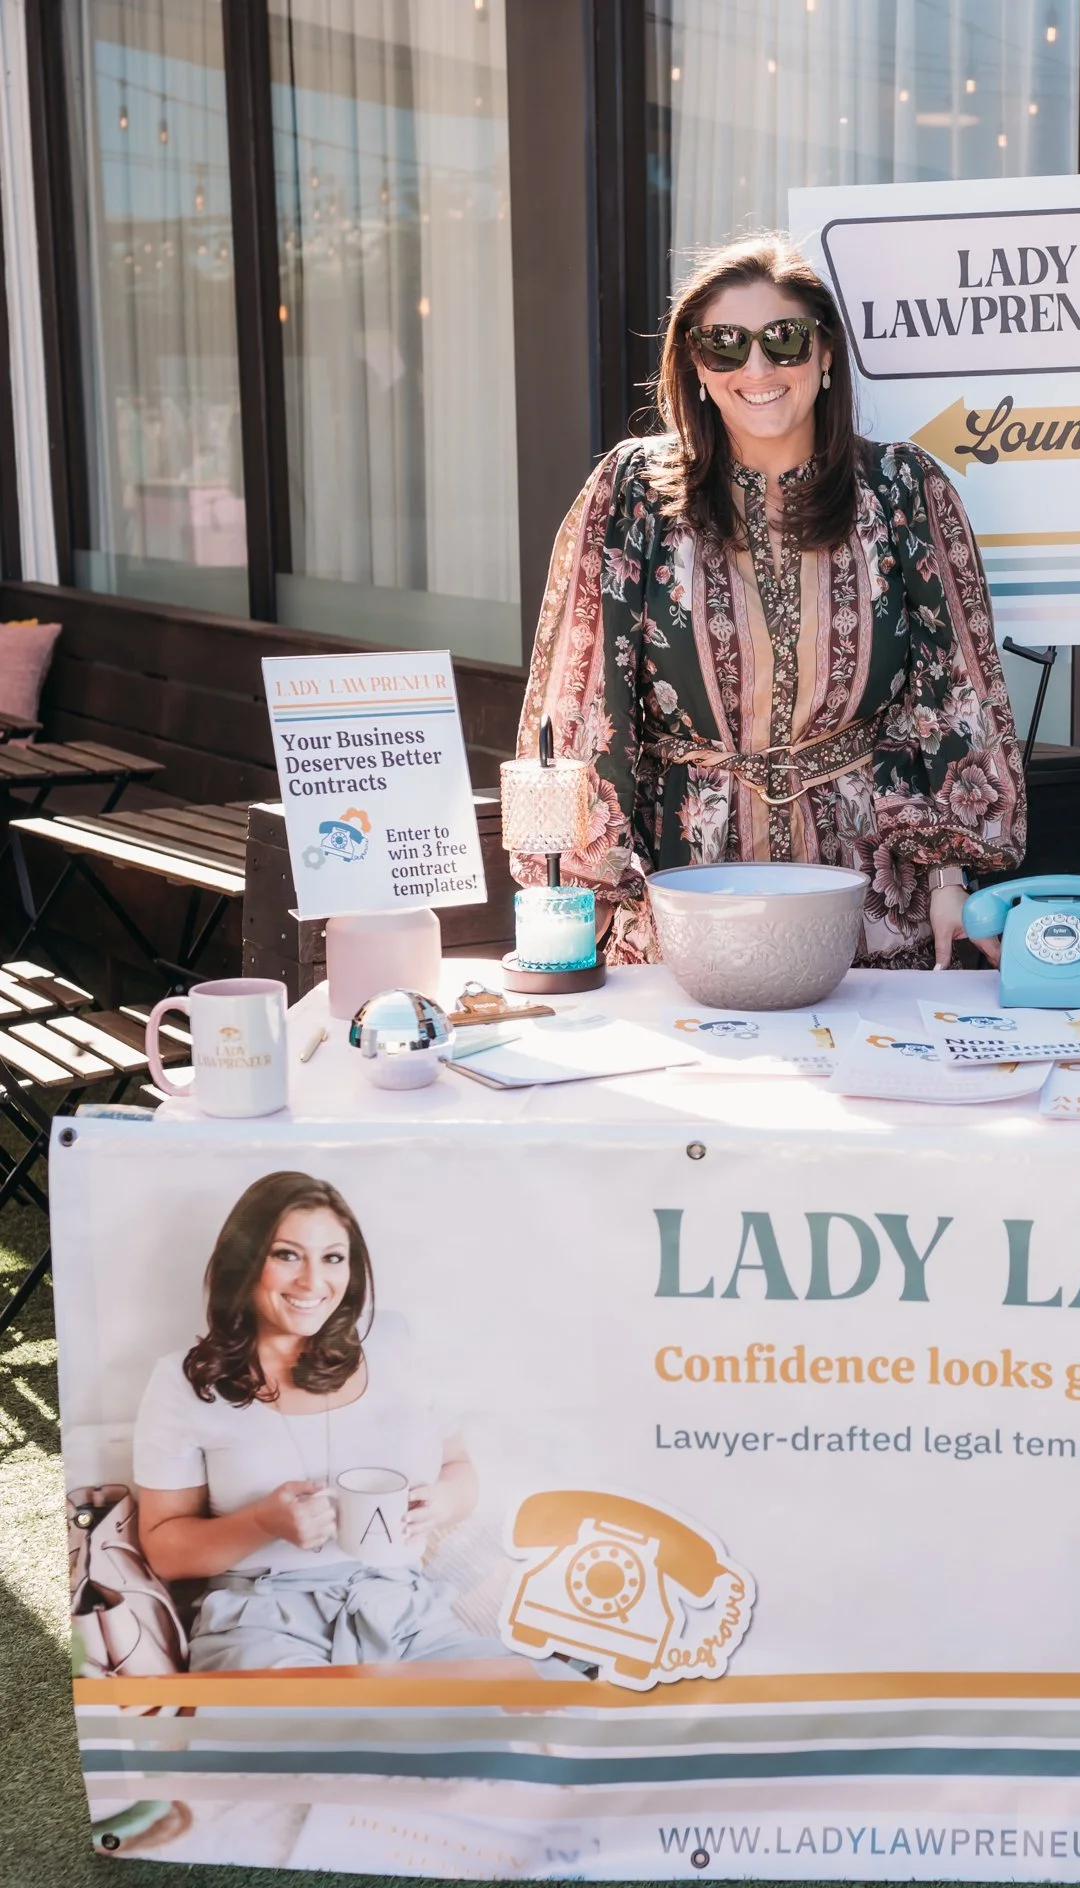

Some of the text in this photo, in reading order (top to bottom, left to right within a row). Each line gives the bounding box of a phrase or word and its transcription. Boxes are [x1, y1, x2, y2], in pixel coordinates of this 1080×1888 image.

[956, 244, 1077, 289] LADY
[275, 673, 447, 697] LADY LAWPRENEUR
[281, 727, 425, 751] Your Business
[284, 750, 442, 774] Deserves Better
[288, 774, 387, 796] Contracts
[386, 825, 450, 843] Enter to
[388, 844, 419, 861] win
[422, 843, 432, 858] 3
[436, 841, 467, 857] free
[391, 860, 458, 879] contract
[393, 874, 478, 897] templates!
[653, 1208, 954, 1302] LADY
[654, 1343, 915, 1384] Confidence
[927, 1347, 1053, 1389] looks
[655, 1424, 911, 1457] Lawyer-drafted
[924, 1427, 1003, 1460] legal
[360, 1506, 392, 1545] A
